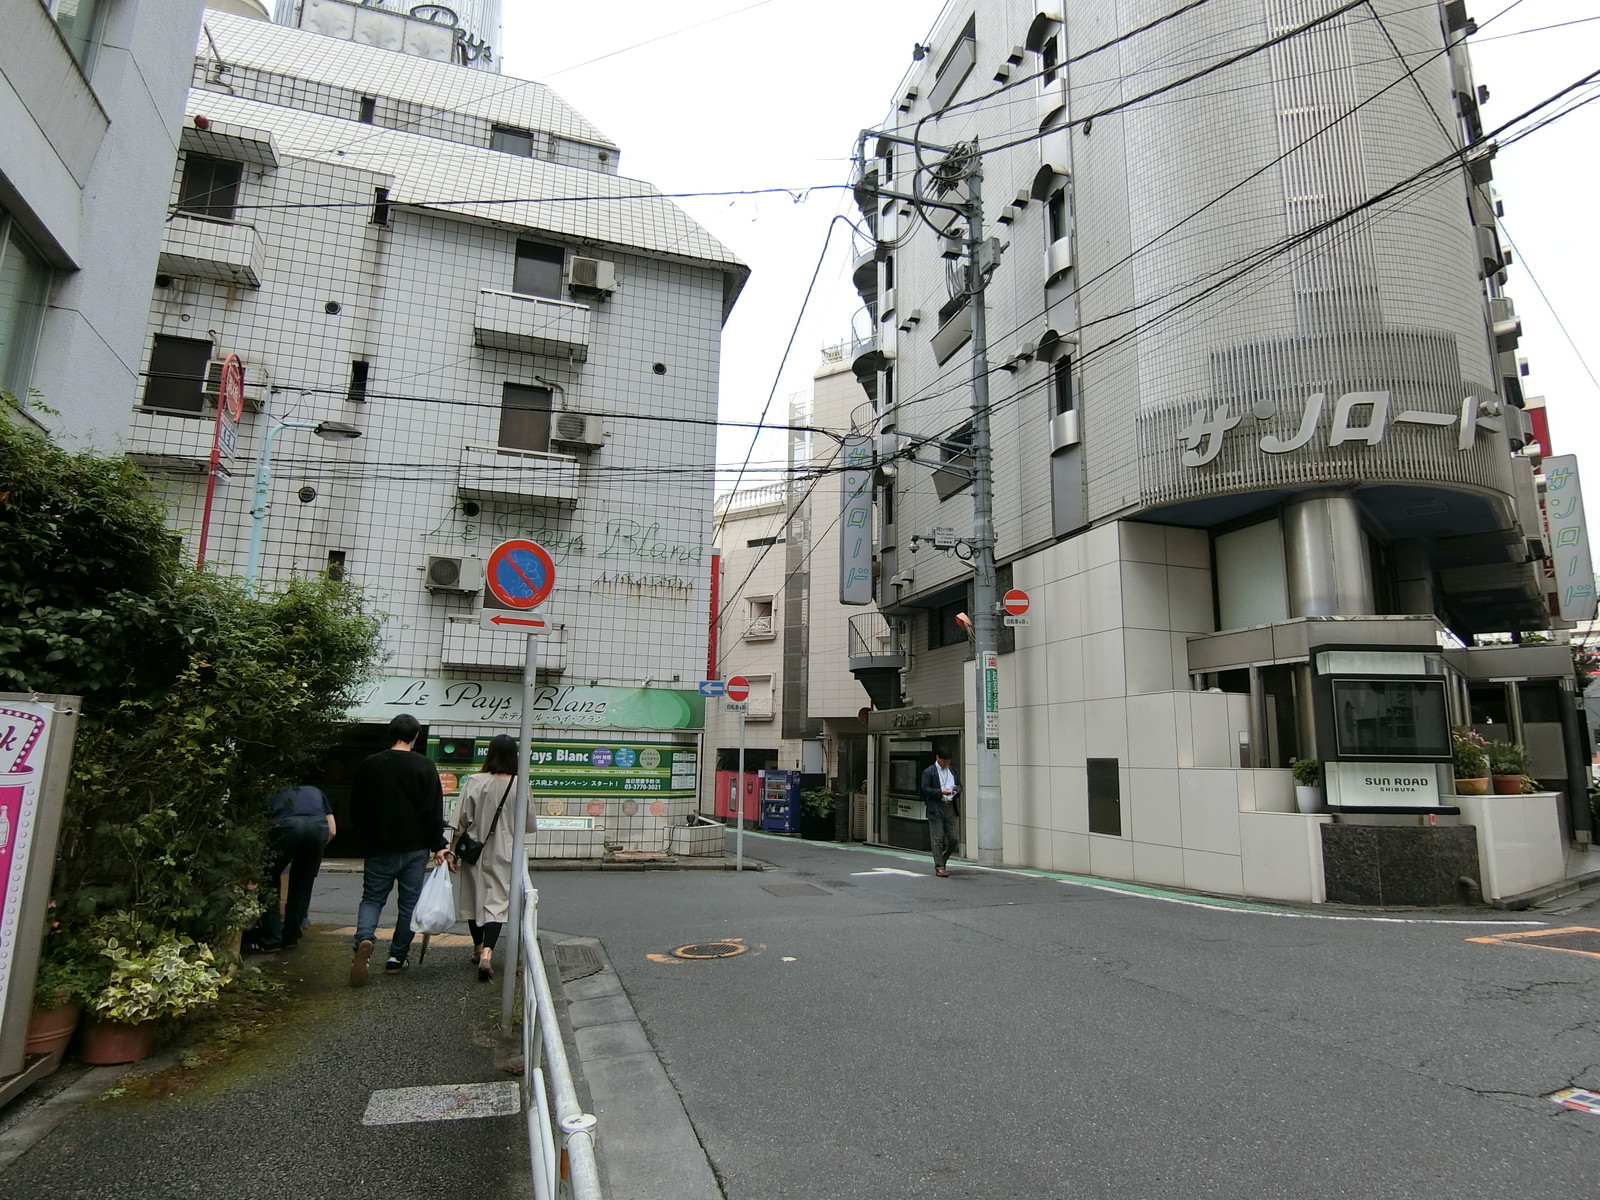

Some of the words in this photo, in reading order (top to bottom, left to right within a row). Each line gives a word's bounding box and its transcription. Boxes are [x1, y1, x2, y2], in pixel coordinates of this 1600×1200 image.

[845, 447, 870, 589] サンロード
[1547, 467, 1592, 608] サンロード
[384, 680, 430, 706] Le
[439, 682, 513, 721] Pays
[532, 685, 607, 714] Blanc
[556, 749, 589, 762] Blanc
[1365, 777, 1391, 786] SUN
[1394, 777, 1429, 787] ROAD
